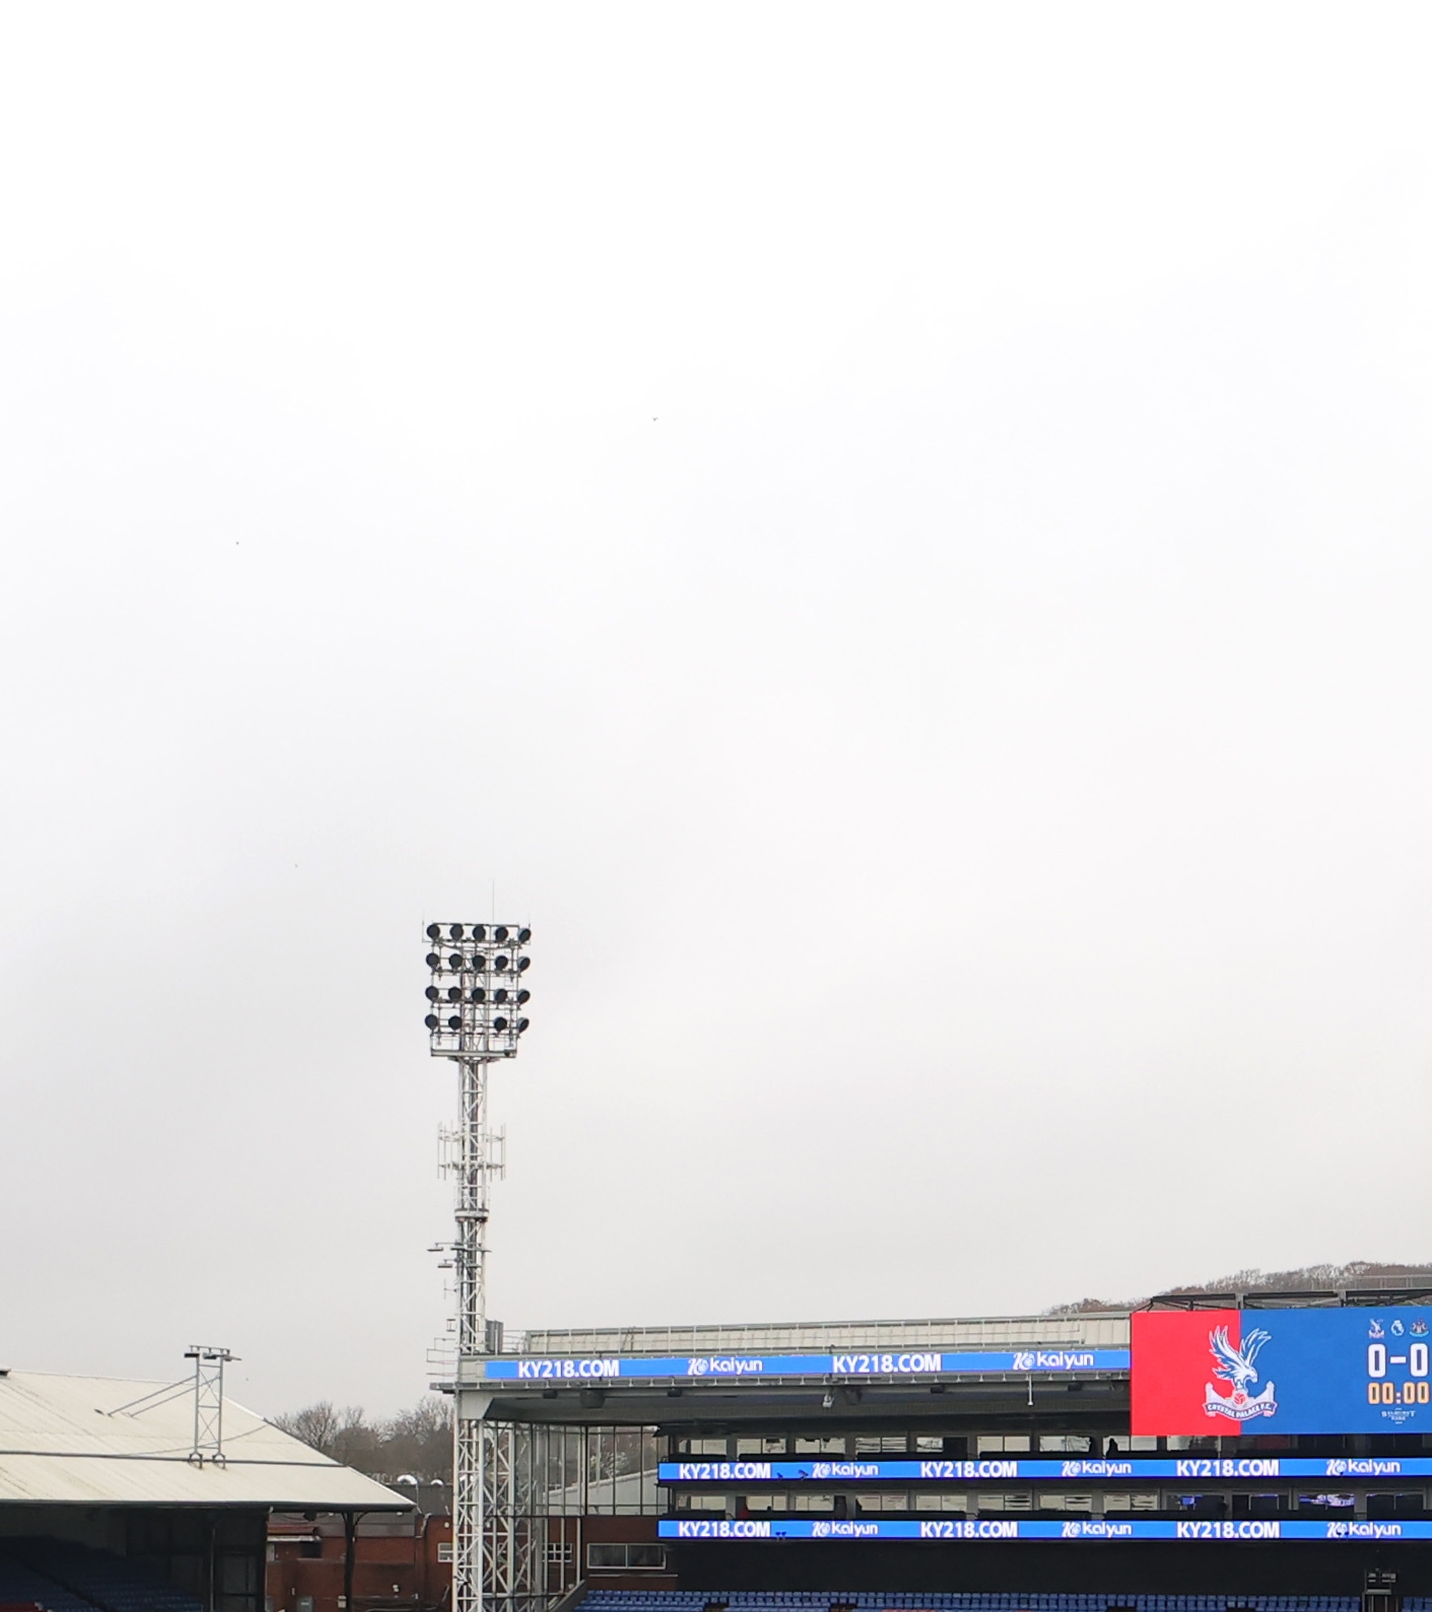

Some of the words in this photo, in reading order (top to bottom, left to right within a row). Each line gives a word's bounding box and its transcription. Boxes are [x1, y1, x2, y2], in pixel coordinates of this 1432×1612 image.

[833, 1354, 942, 1373] KY218.COM
[1369, 1344, 1428, 1377] 0-0
[518, 1360, 619, 1378] KY218.COM
[1368, 1382, 1429, 1404] 00:00
[679, 1463, 770, 1479] KY218.COM
[921, 1461, 1017, 1477] KY218.COM
[1177, 1460, 1279, 1476] KY218.COM
[679, 1521, 770, 1537] KY218.COM
[921, 1521, 1017, 1537] KY218.COM
[1177, 1522, 1279, 1538] KY218.COM
